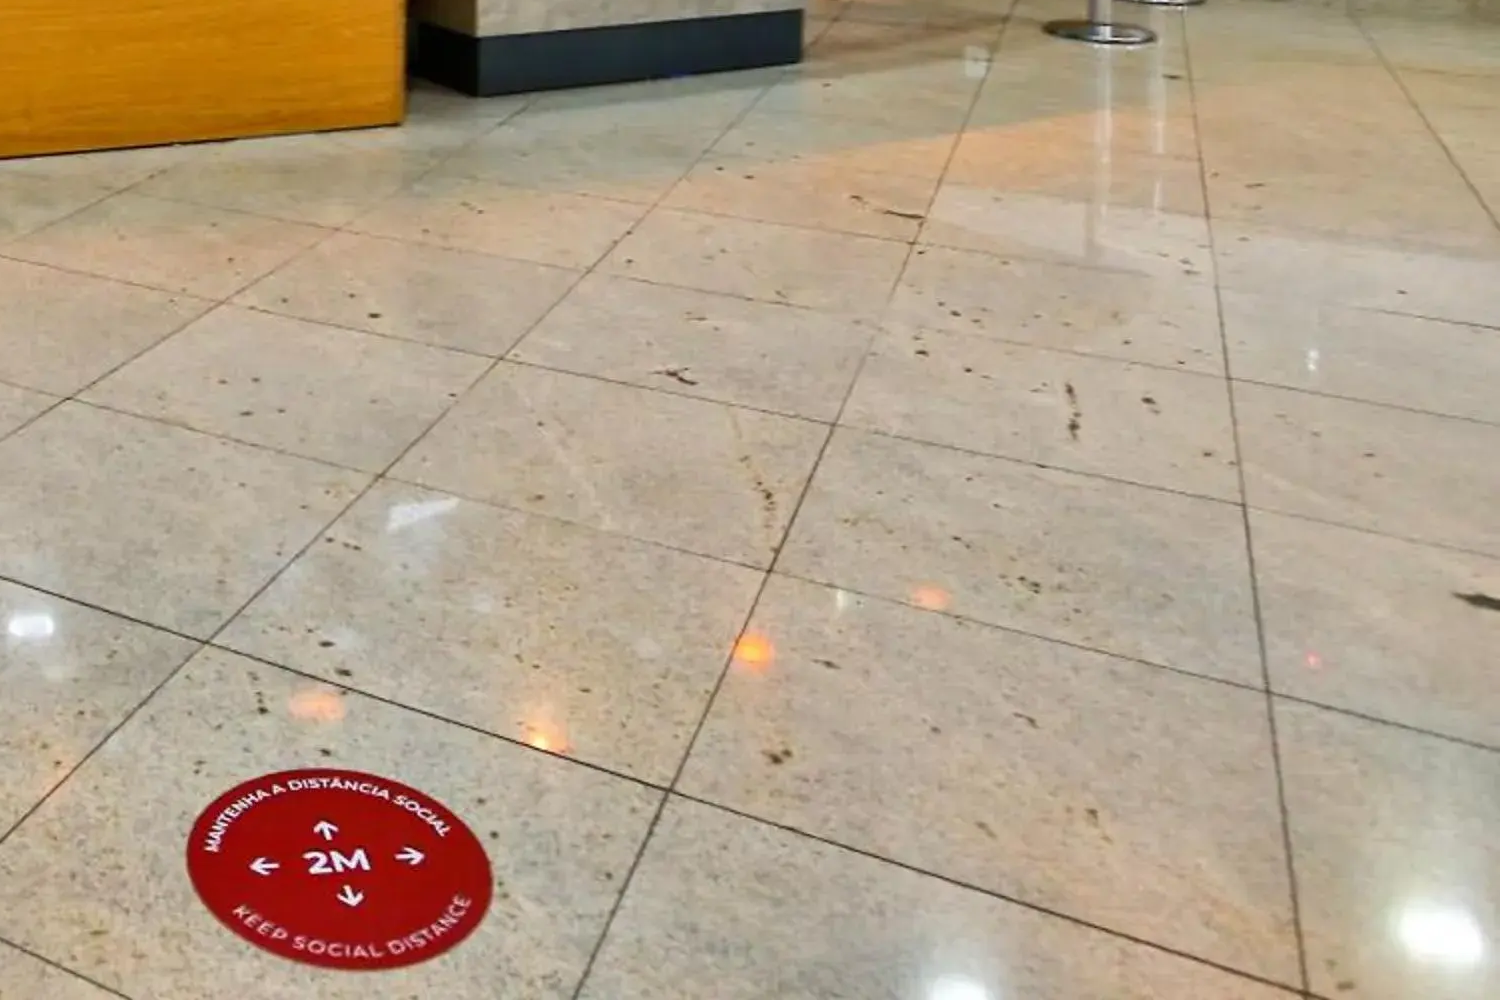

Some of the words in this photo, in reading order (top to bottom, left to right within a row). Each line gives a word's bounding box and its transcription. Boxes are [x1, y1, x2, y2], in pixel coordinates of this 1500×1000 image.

[204, 788, 271, 853] MANTENHA
[271, 783, 287, 795] A
[392, 794, 451, 837] SOCIAL
[302, 848, 372, 875] 2M
[232, 905, 288, 940] KEEP
[292, 935, 383, 958] SOCIAL
[387, 895, 472, 955] DISTANCE
